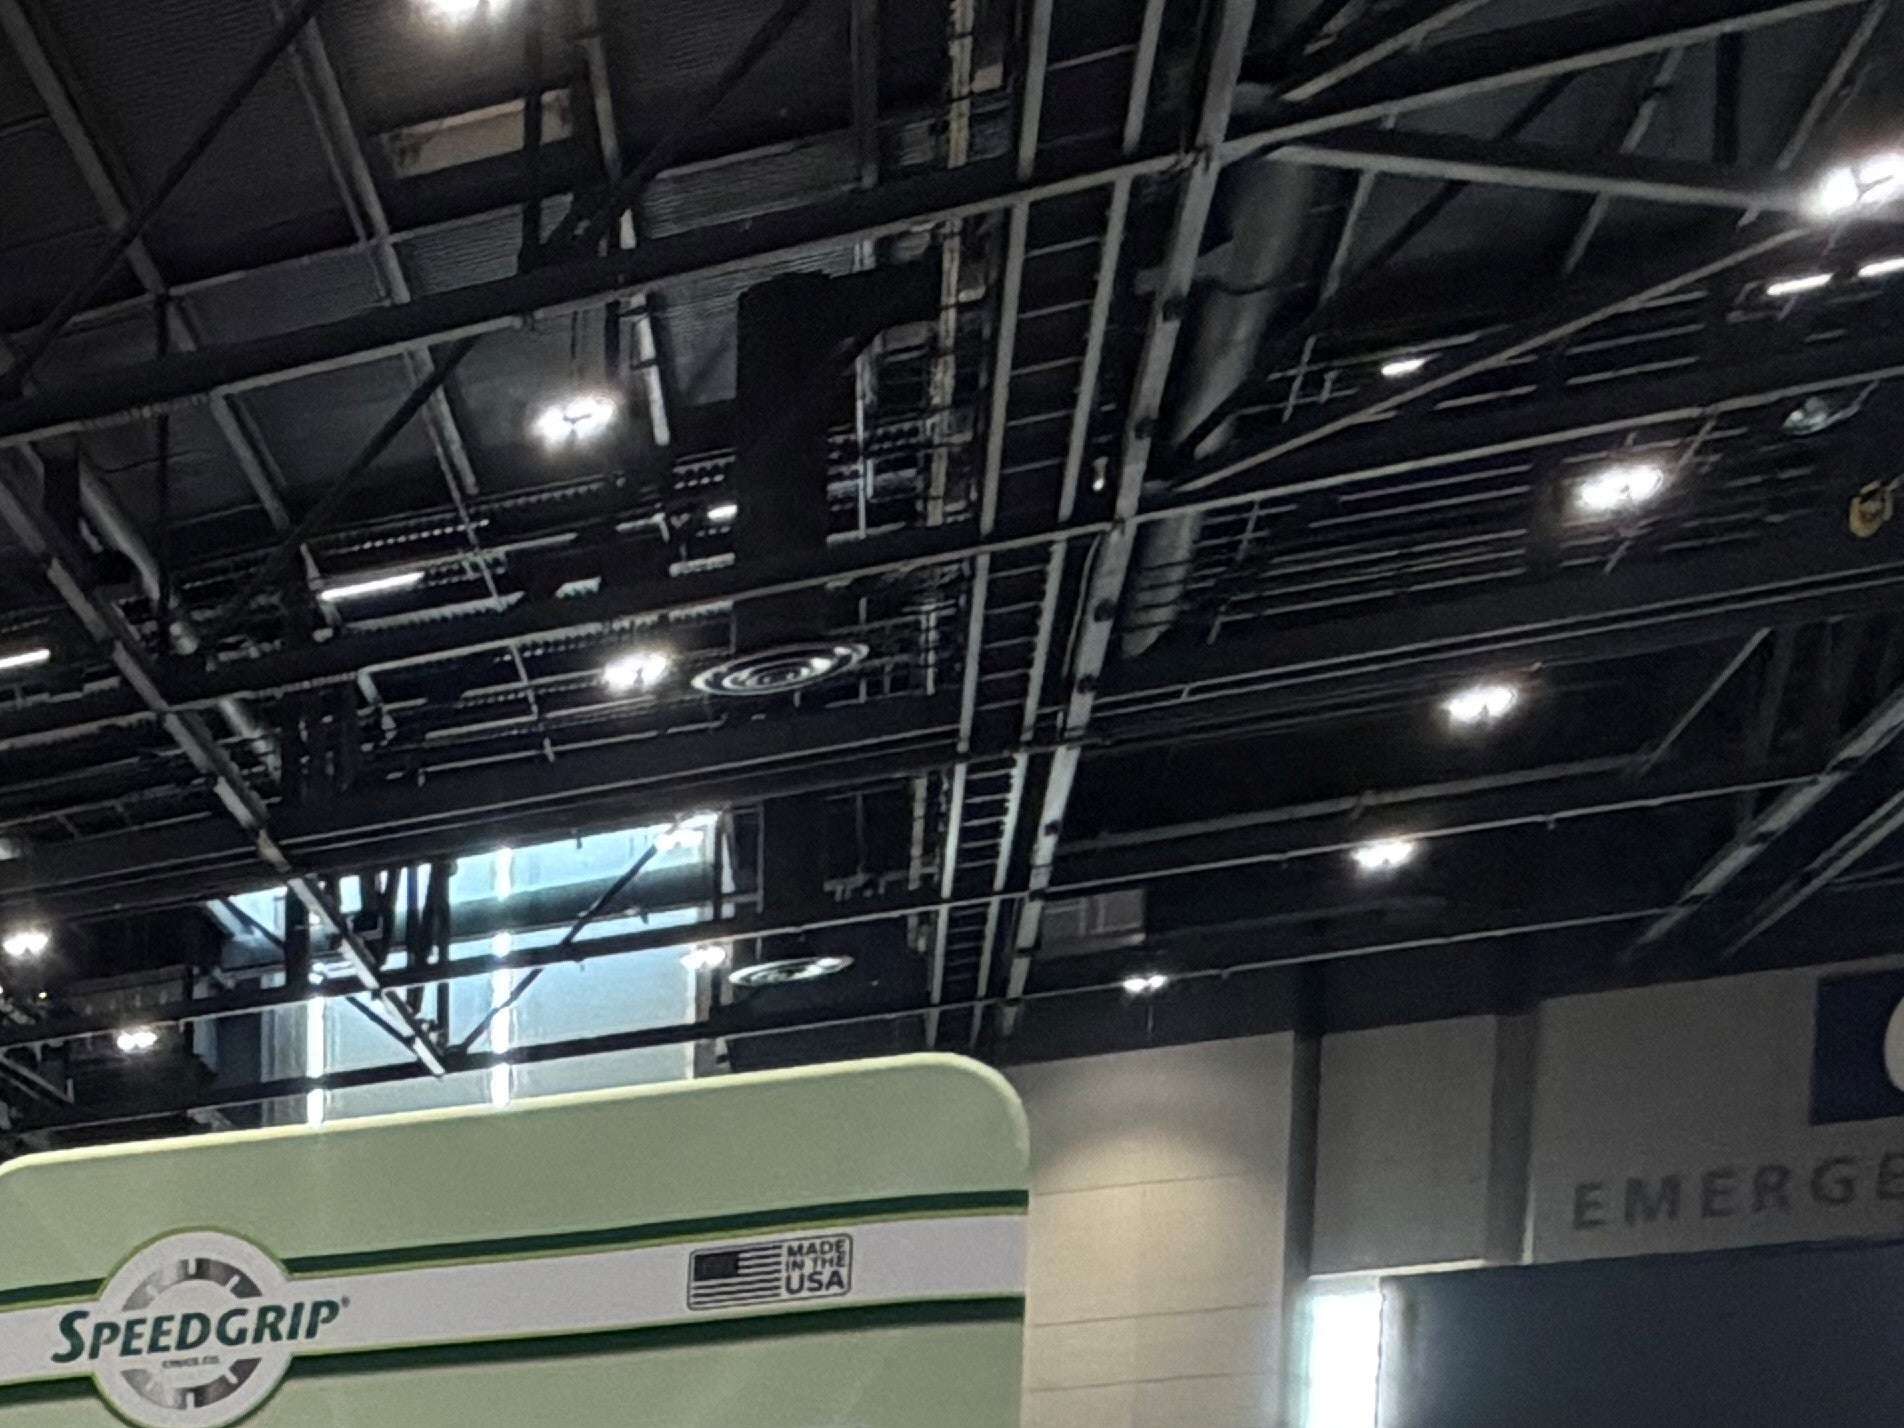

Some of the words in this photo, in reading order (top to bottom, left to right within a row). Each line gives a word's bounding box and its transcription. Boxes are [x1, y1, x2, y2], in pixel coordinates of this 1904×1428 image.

[786, 1238, 846, 1259] MADE
[785, 1256, 806, 1274] IN
[810, 1249, 846, 1271] THE
[785, 1270, 845, 1294] USA
